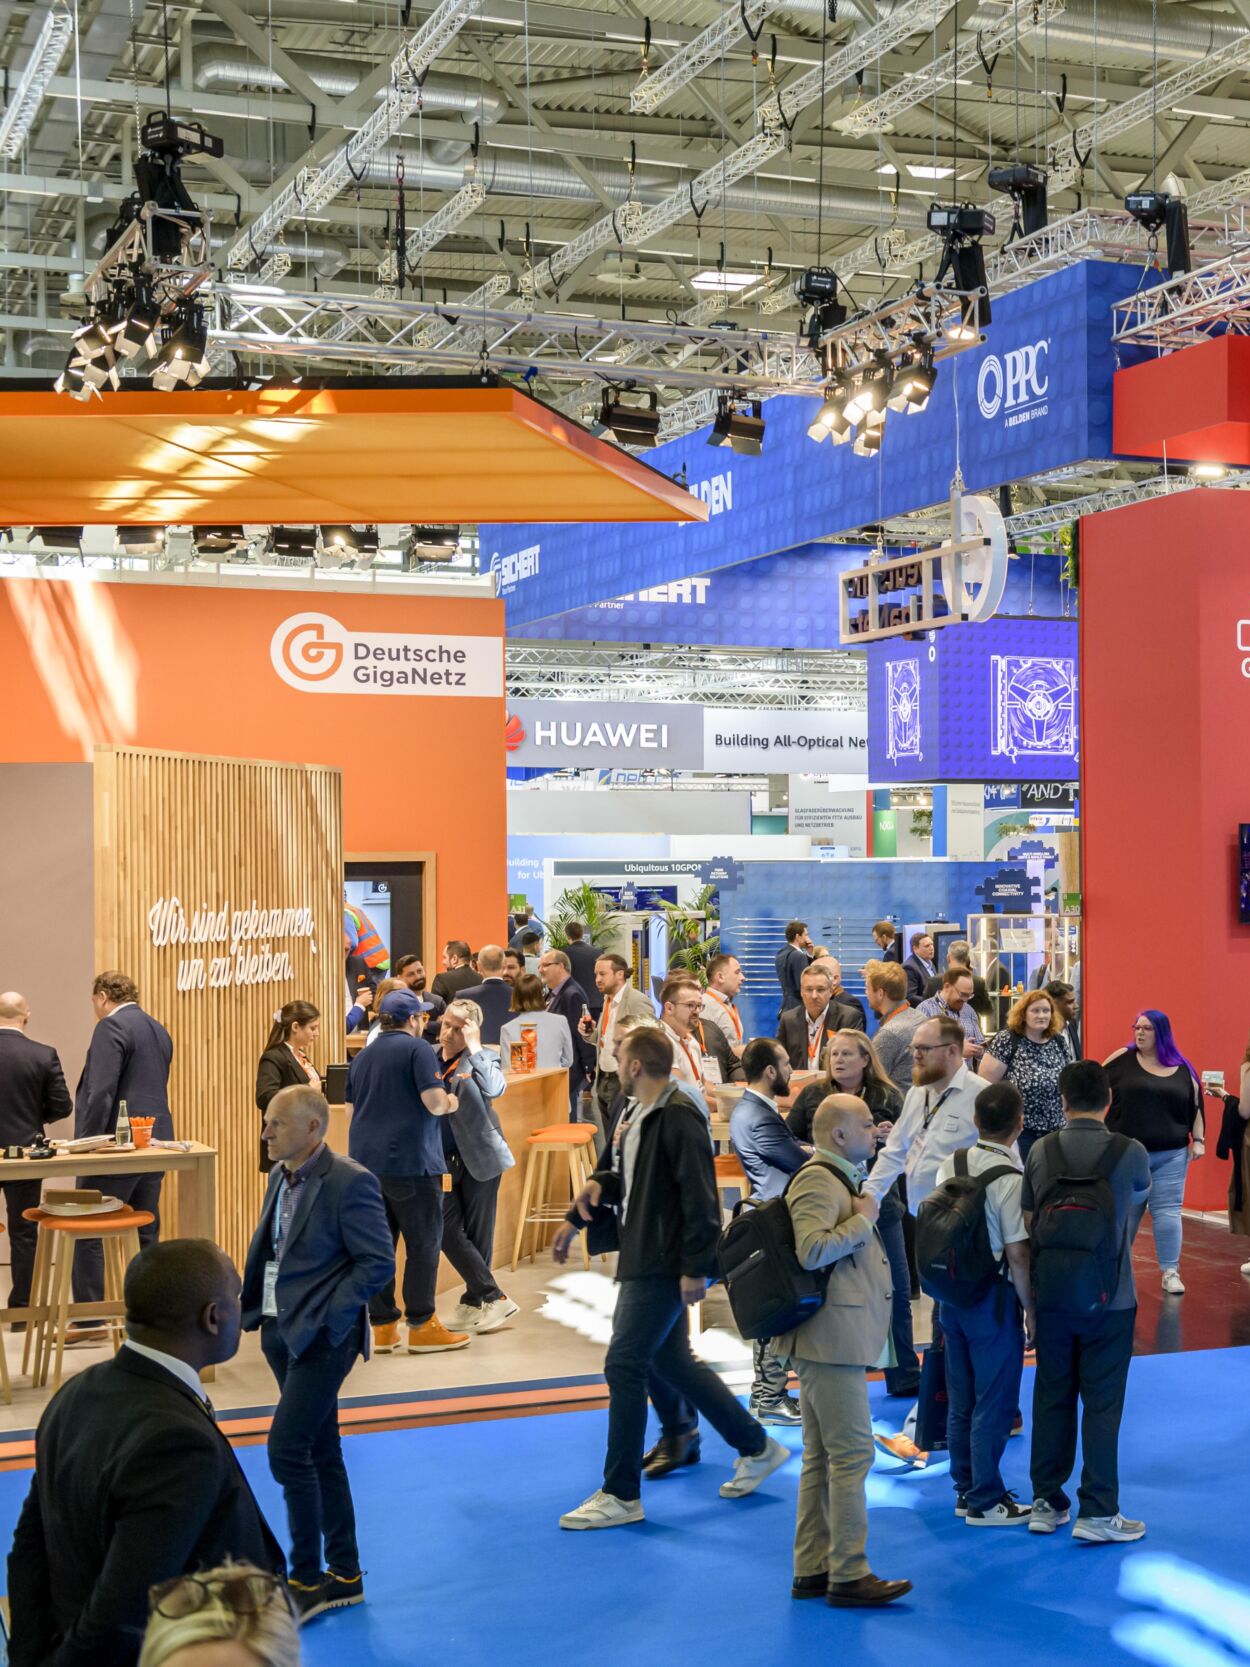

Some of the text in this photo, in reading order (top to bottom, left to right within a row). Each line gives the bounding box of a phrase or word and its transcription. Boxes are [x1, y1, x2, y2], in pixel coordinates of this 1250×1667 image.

[1009, 411, 1030, 427] BELDEN
[1030, 405, 1049, 419] BRAND
[501, 544, 540, 585] SICHERT
[353, 642, 467, 663] Deutsche
[353, 666, 467, 687] GigaNetz
[535, 721, 668, 748] HUAWEI
[715, 734, 769, 750] Building
[774, 735, 843, 750] All-Optical
[508, 857, 539, 868] uilding
[624, 863, 669, 873] Ubiquitous
[518, 870, 530, 879] for
[1064, 905, 1080, 913] A30
[149, 896, 318, 955] Wir sind gekommen,
[177, 943, 294, 991] um zu bleiben.
